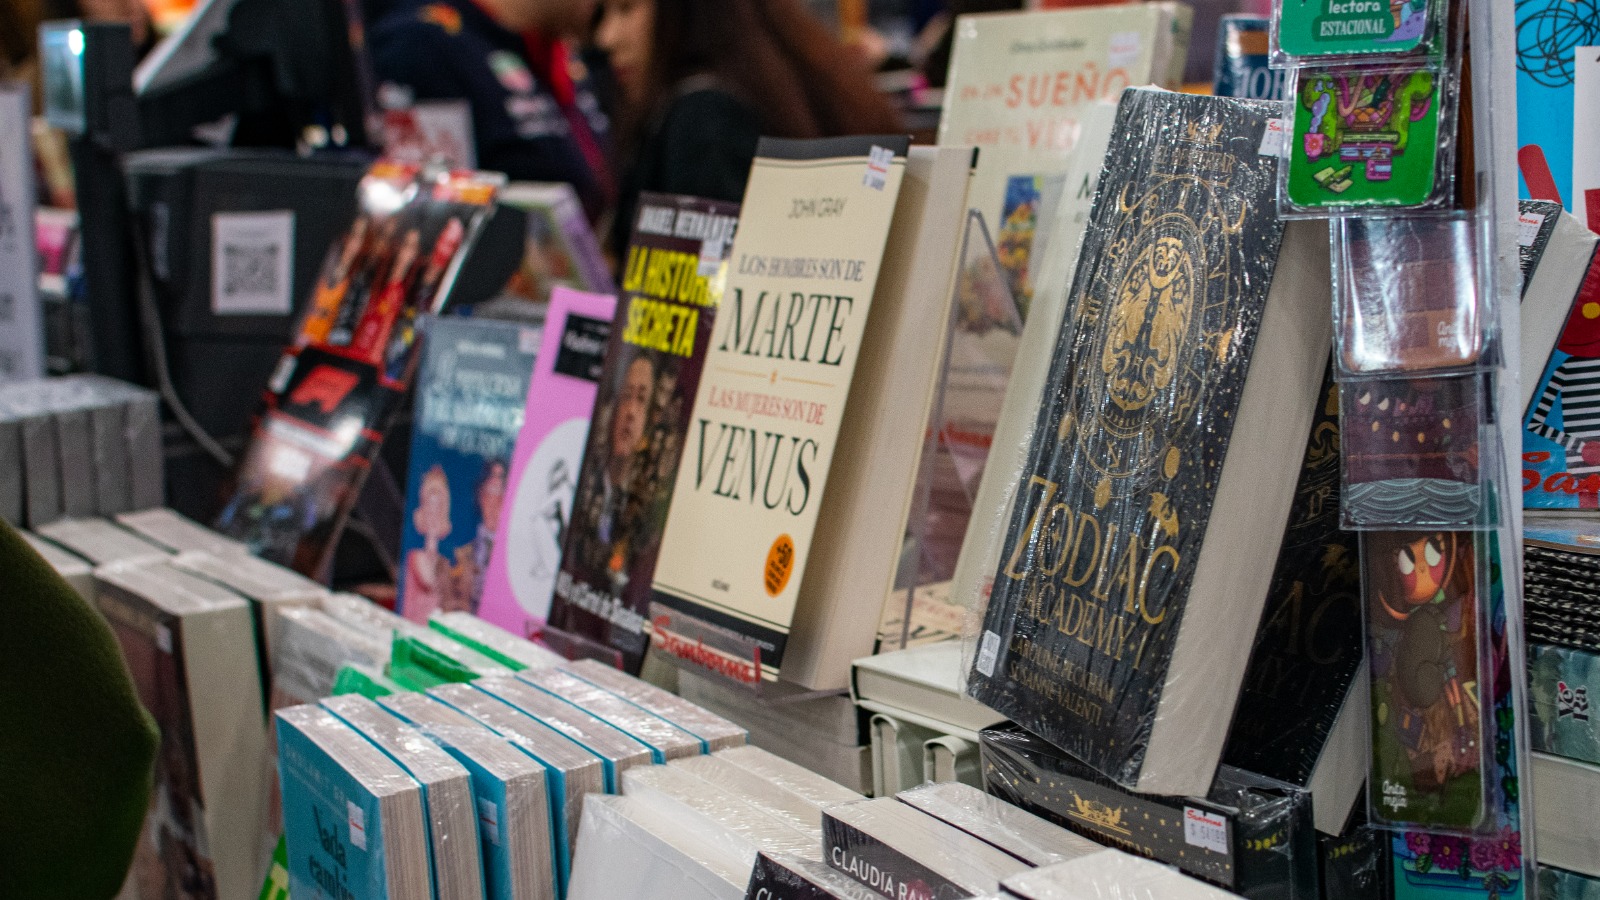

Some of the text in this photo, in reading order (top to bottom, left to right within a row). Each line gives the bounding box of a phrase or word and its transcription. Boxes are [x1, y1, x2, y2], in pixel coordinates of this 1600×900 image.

[1320, 18, 1386, 37] ESTACIONAL
[1328, 0, 1381, 14] lectora
[1006, 61, 1131, 108] SUEÑO
[843, 259, 867, 282] DE
[718, 287, 854, 367] MARTE
[805, 402, 827, 425] DE
[695, 418, 819, 516] VENUS
[1003, 474, 1181, 625] ZODIAC
[1026, 576, 1137, 661] ACADEMY
[832, 847, 895, 897] CLAUDIA
